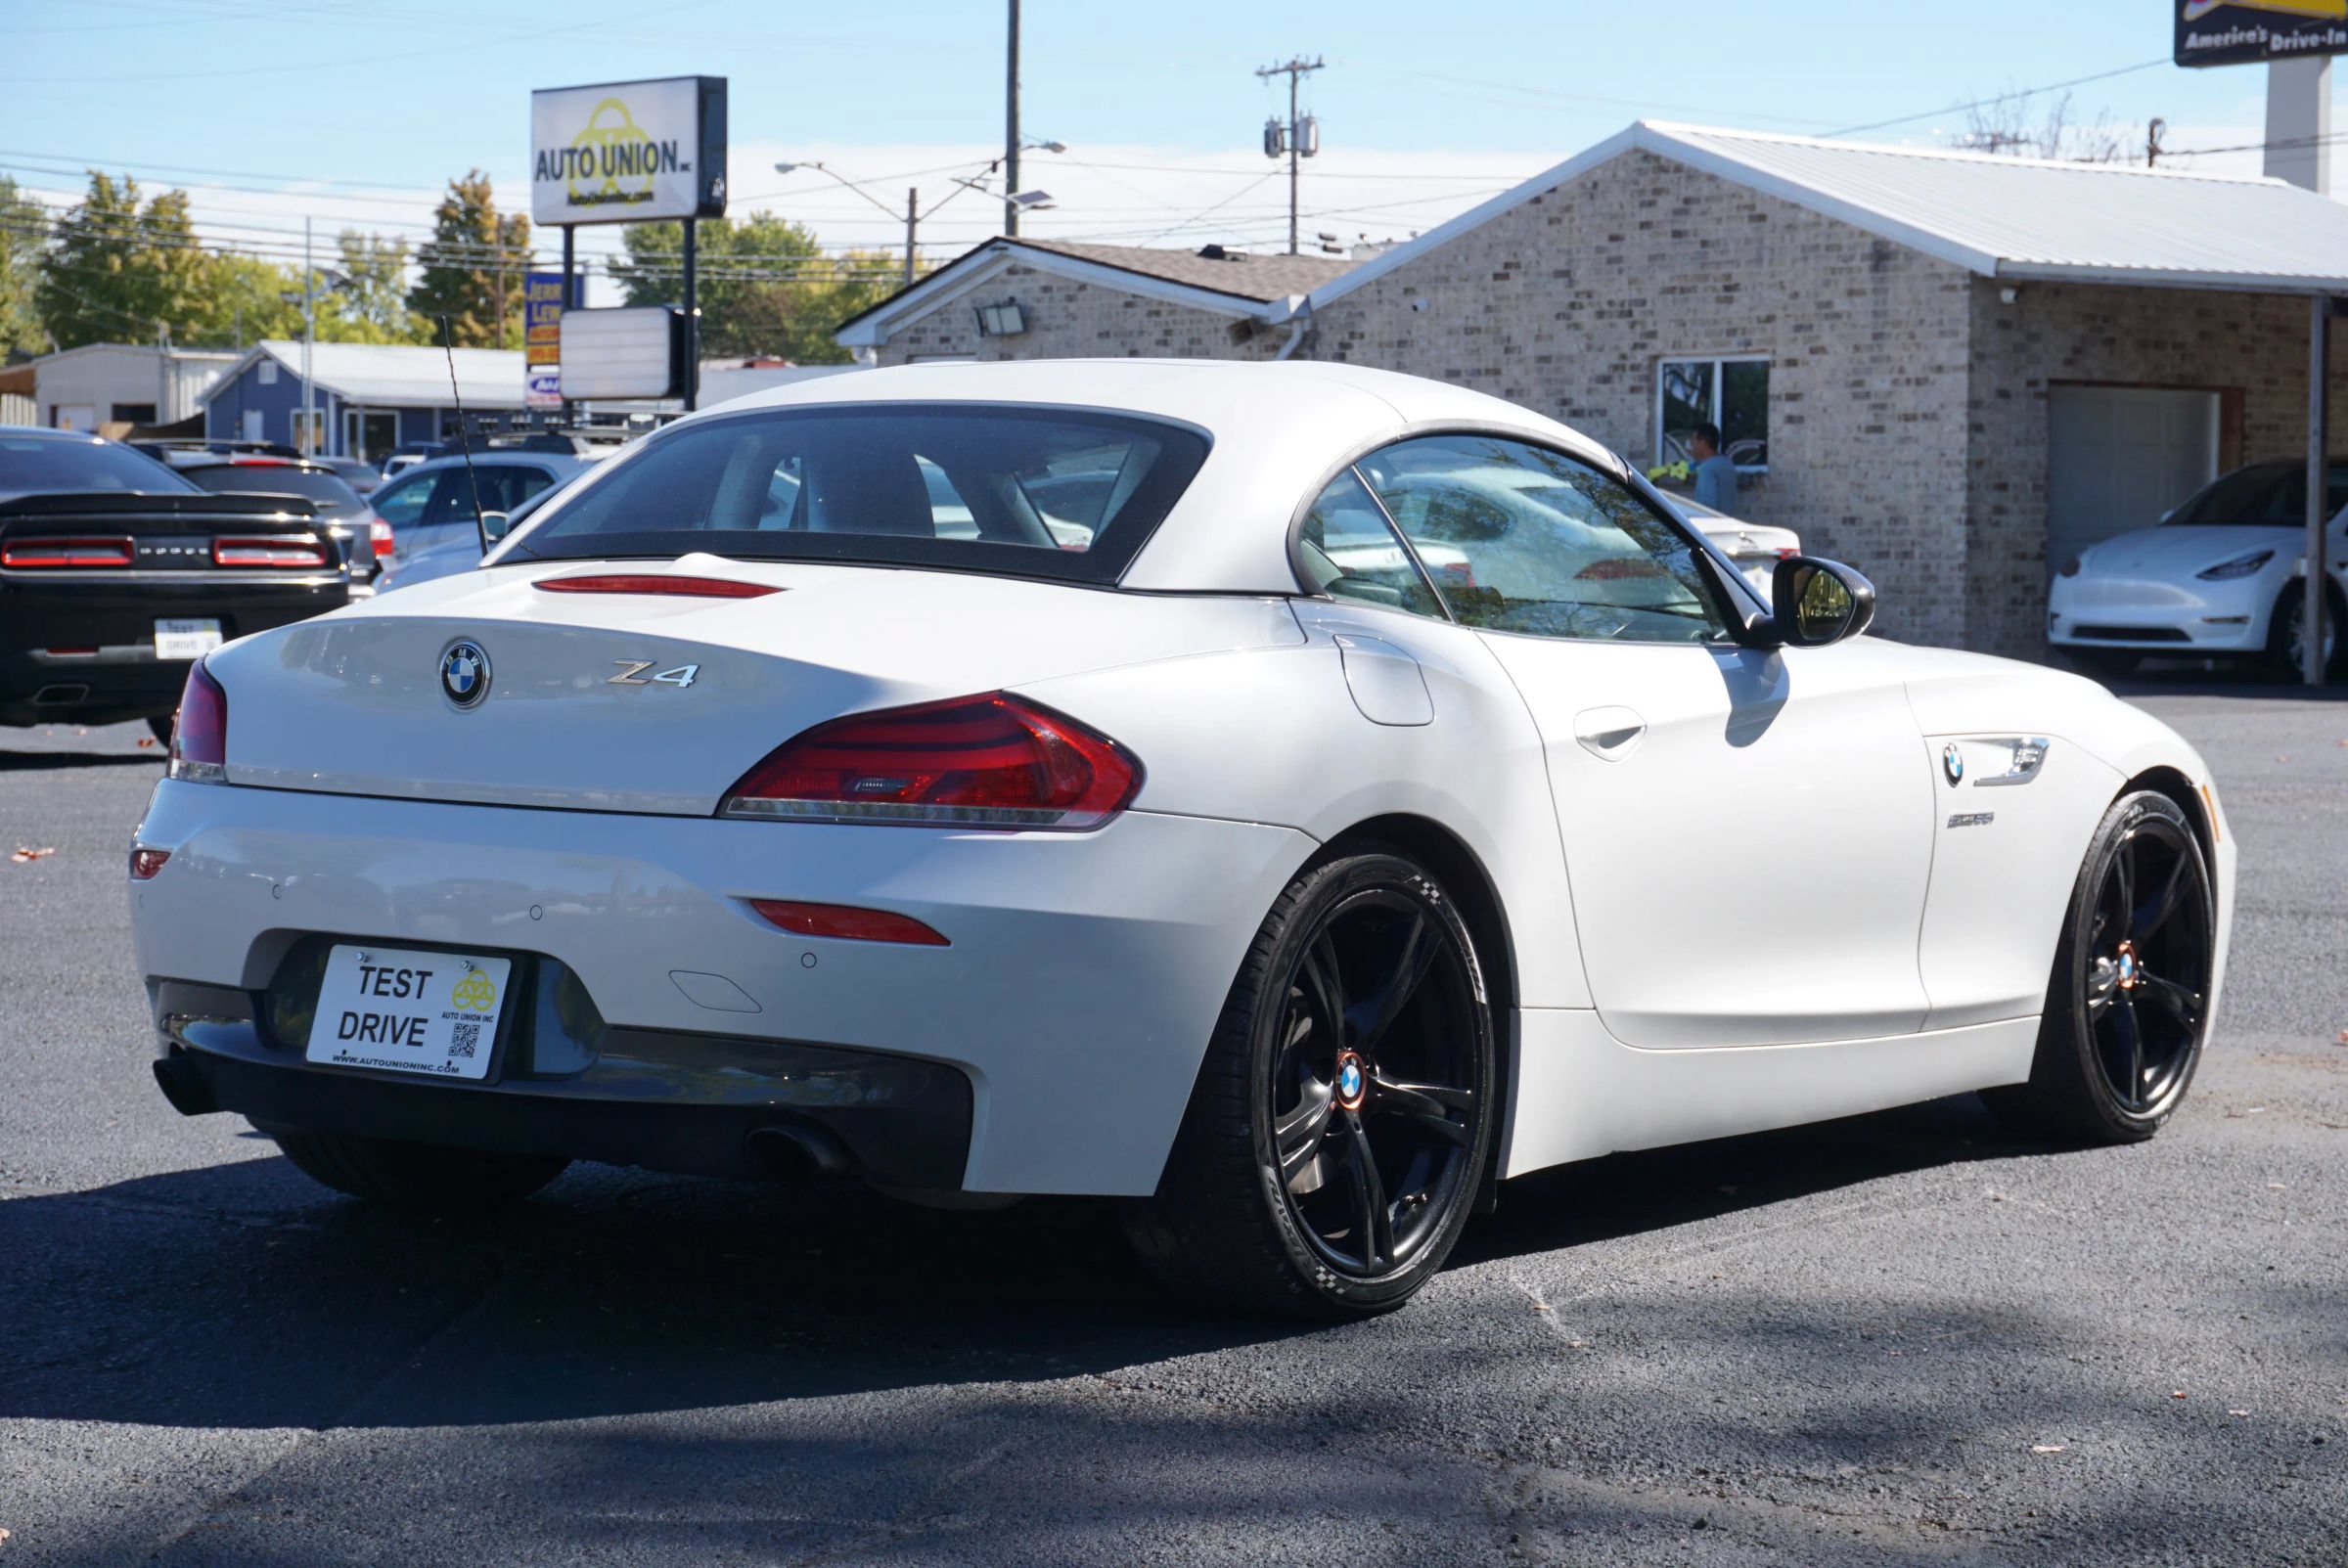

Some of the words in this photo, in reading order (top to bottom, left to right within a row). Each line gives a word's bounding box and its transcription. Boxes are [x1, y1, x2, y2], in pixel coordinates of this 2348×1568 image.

[2185, 23, 2268, 48] America's
[535, 147, 595, 181] AUTO
[602, 140, 677, 177] UNION
[445, 648, 480, 666] BMW
[606, 658, 701, 688] Z4
[359, 965, 433, 1000] TEST
[338, 1010, 429, 1047] DRIVE
[441, 1011, 459, 1020] AUTO
[460, 1013, 482, 1022] UNION
[333, 1054, 460, 1074] WWW.AUTOUNIONINC.COM
